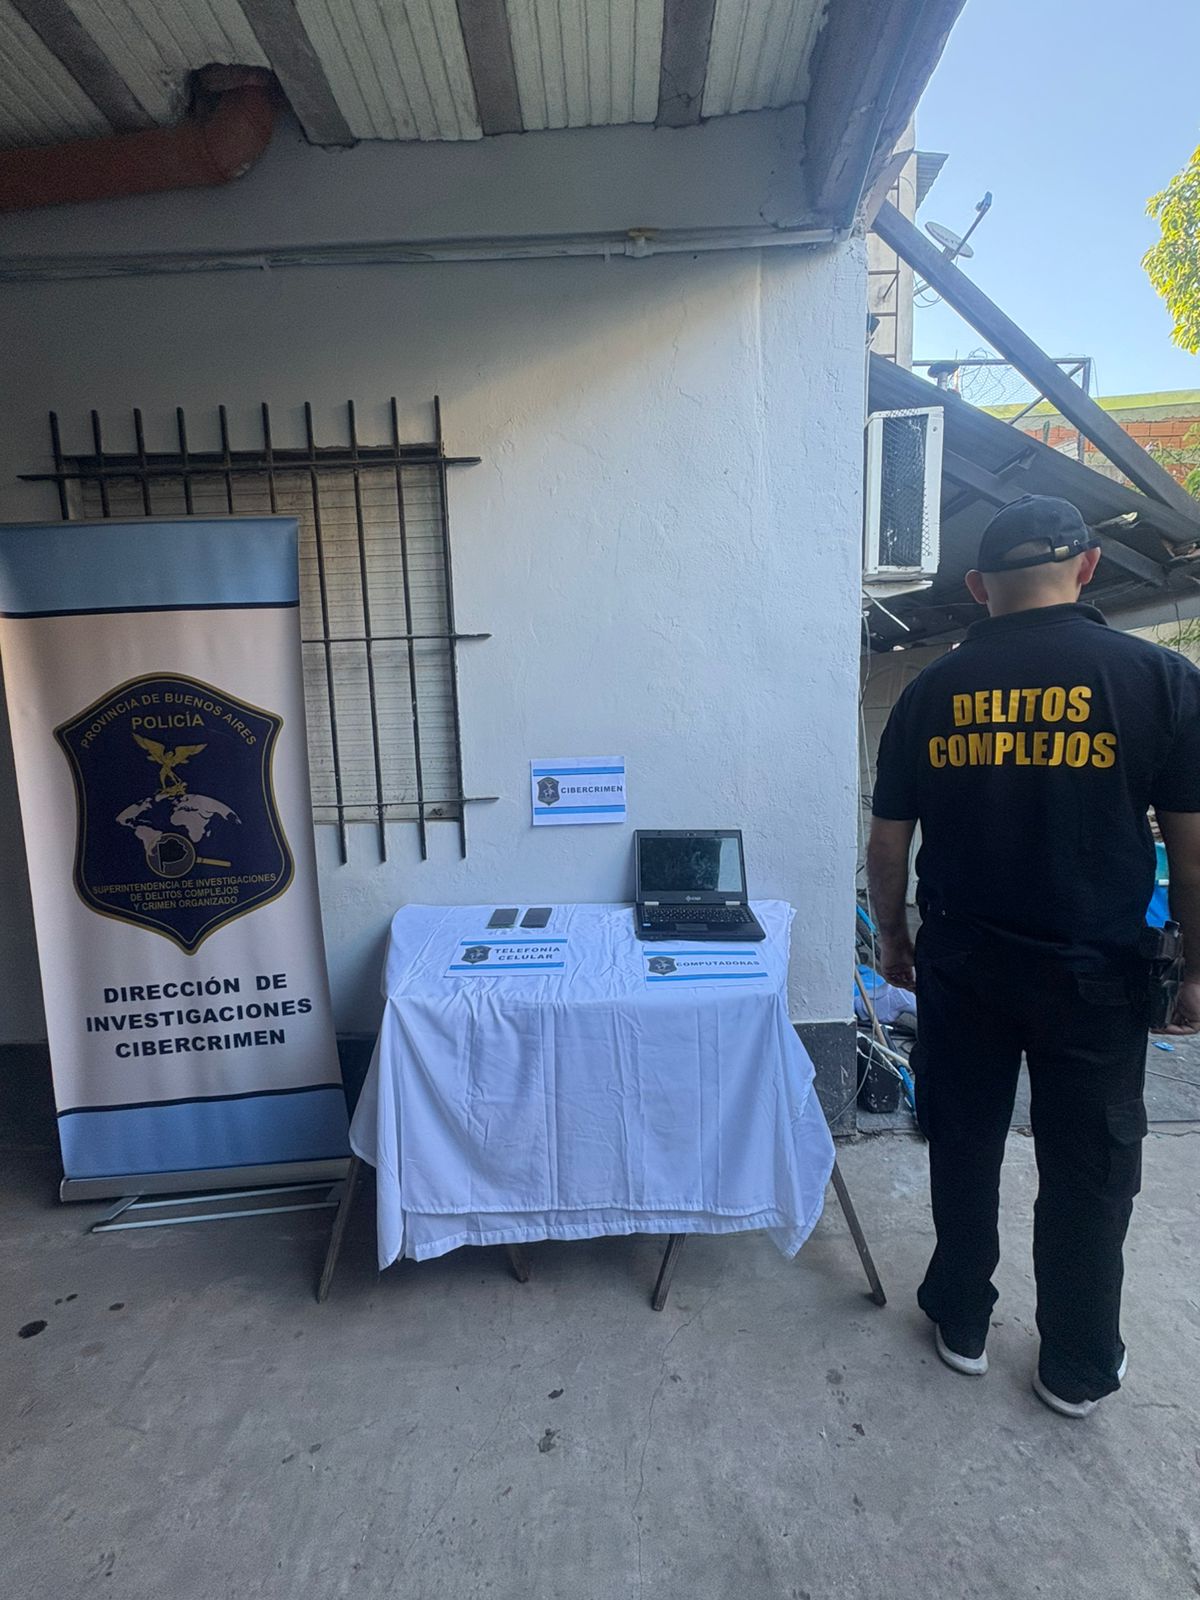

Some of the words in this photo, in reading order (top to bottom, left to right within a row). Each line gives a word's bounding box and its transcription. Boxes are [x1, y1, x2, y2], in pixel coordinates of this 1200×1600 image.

[952, 685, 1093, 727] DELITOS
[80, 698, 140, 749] PROVINCIA
[142, 693, 160, 706] DE
[164, 692, 223, 716] BUENOS
[222, 712, 257, 745] AIRES
[131, 711, 205, 730] POLICÍA
[928, 731, 1117, 768] COMPLEJOS
[561, 785, 623, 794] CIBERCRIMEN
[92, 880, 179, 895] SUPERINTENDENCIA
[181, 879, 194, 888] DE
[195, 873, 277, 887] INVESTIGACIONES
[130, 892, 143, 902] DE
[145, 889, 182, 901] DELITOS
[184, 886, 240, 898] COMPLEJOS
[141, 901, 177, 911] CRIMEN
[178, 896, 238, 908] ORGANIZADO
[495, 946, 560, 954] TELEFONÍA
[498, 953, 553, 961] CELULAR
[676, 959, 760, 967] COMPUTADORAS
[104, 976, 240, 1003] DIRECCIÓN
[255, 973, 287, 991] DE
[86, 998, 313, 1032] INVESTIGACIONES
[115, 1029, 285, 1058] CIBERCRIMEN
